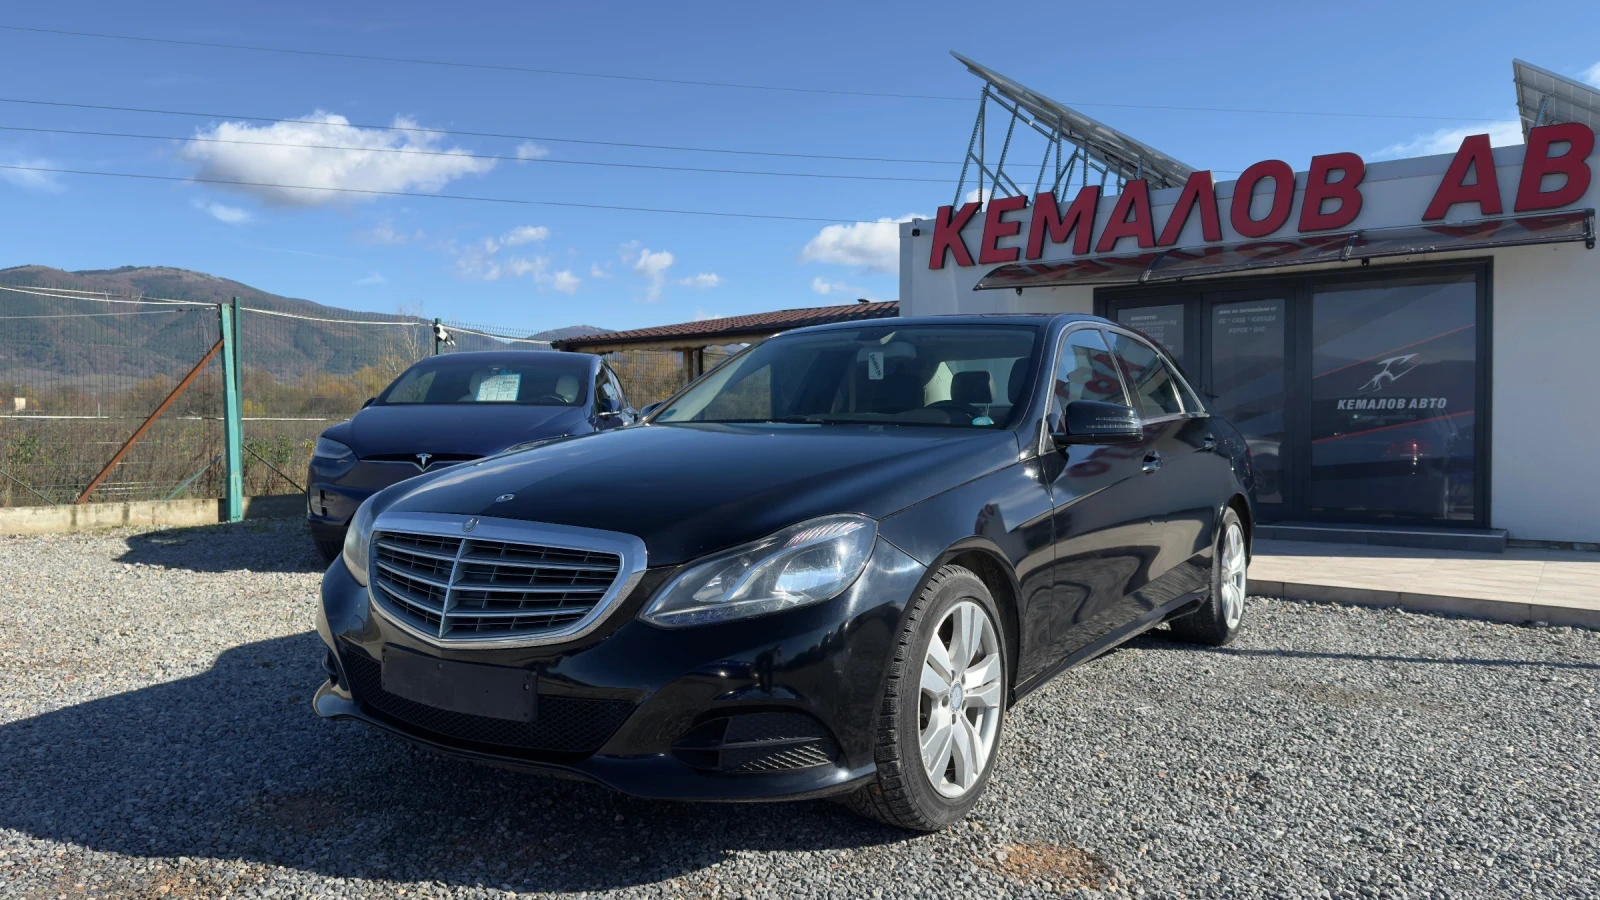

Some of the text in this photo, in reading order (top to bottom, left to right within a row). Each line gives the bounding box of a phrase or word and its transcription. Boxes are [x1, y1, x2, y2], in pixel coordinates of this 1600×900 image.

[929, 122, 1595, 270] КЕМАЛОВ АВ
[1337, 397, 1447, 410] КЕМАЛОВ АВТО
